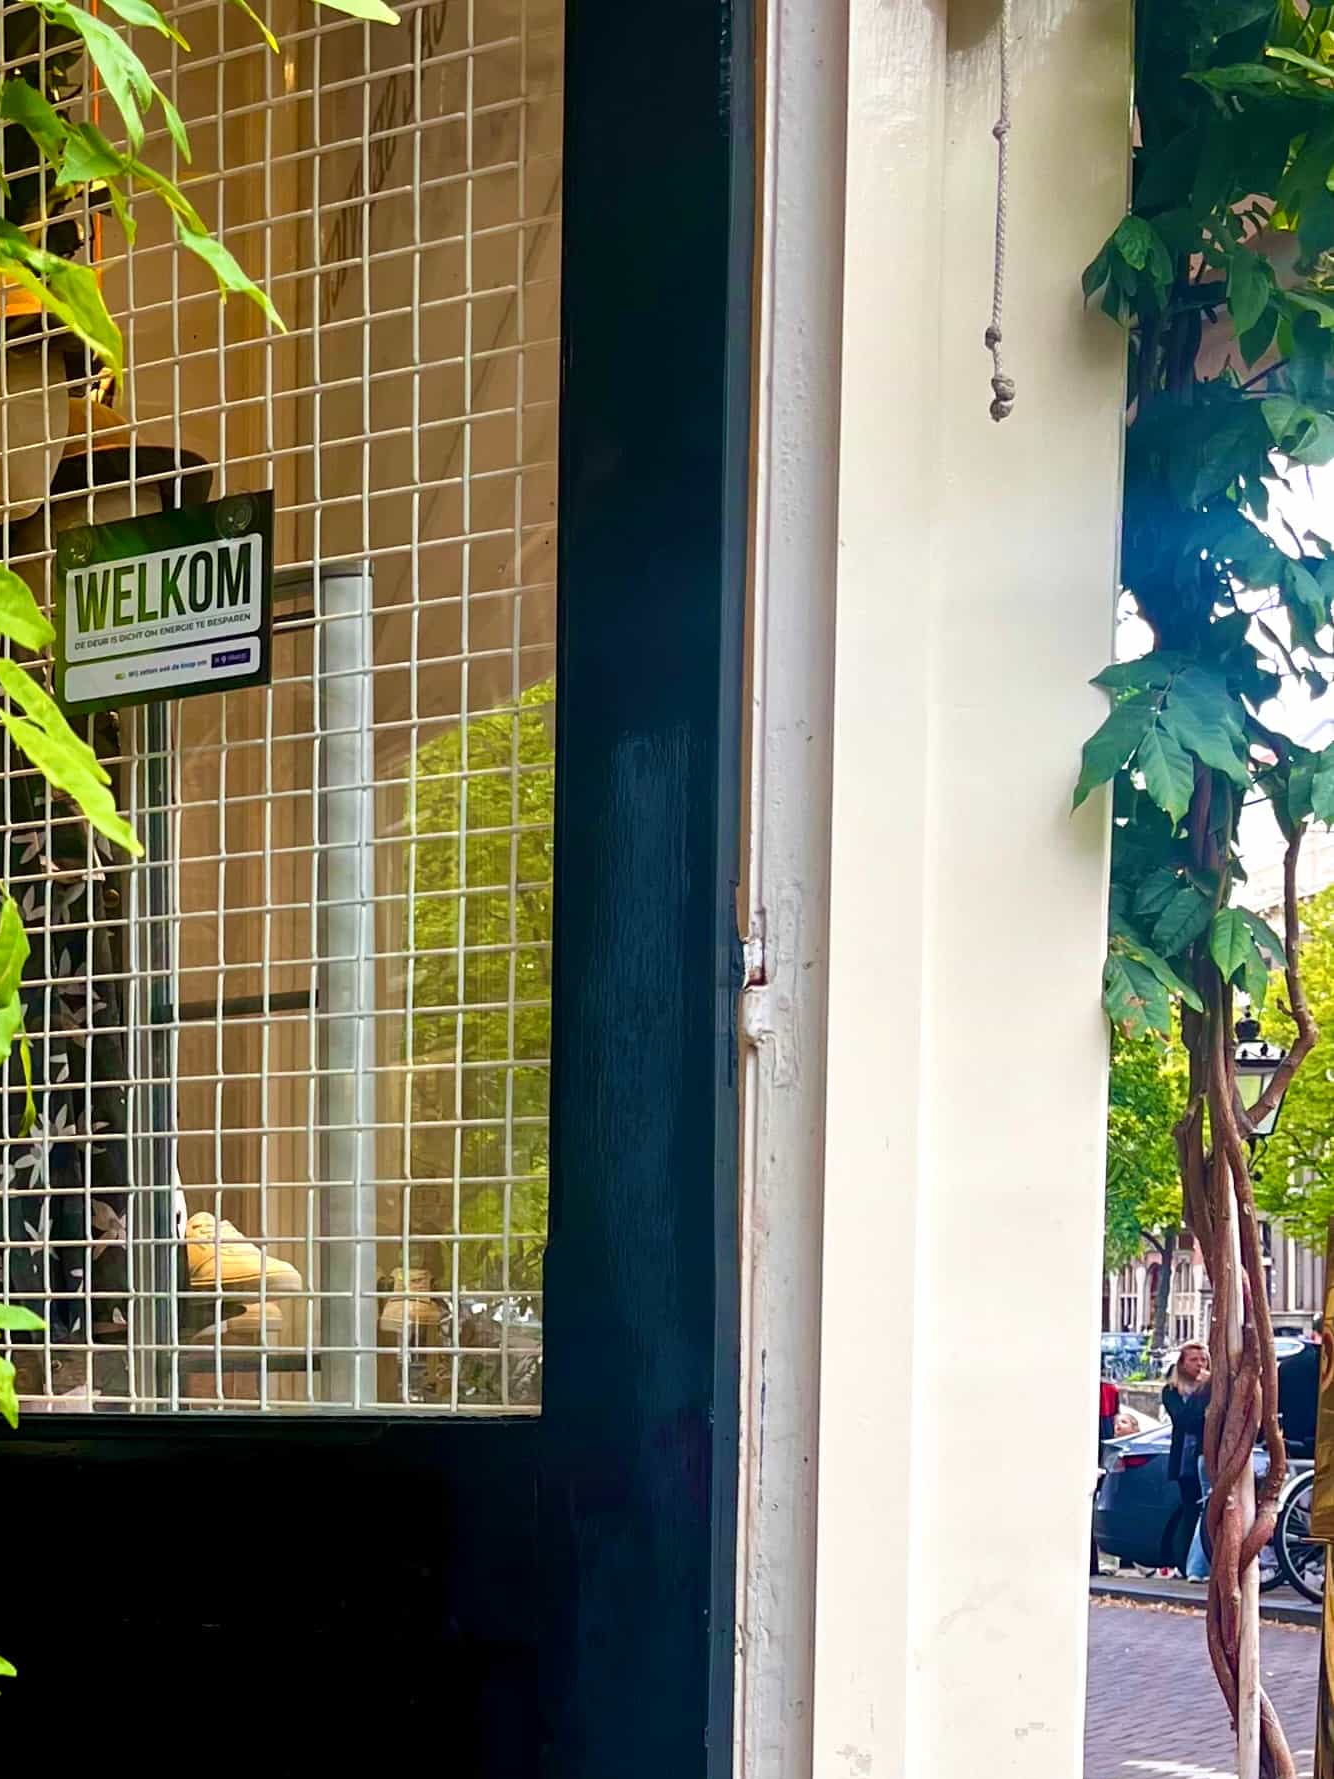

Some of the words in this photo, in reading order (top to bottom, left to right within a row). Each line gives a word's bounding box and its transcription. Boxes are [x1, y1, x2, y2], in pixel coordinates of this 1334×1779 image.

[74, 542, 252, 634] WELKOM
[74, 640, 85, 651] DE
[87, 637, 109, 649] DEUR
[110, 635, 118, 645] IS
[119, 631, 144, 643] DICHT
[160, 622, 195, 636] ENERGIE
[196, 620, 206, 629] TE
[207, 612, 251, 627] BESPAREN
